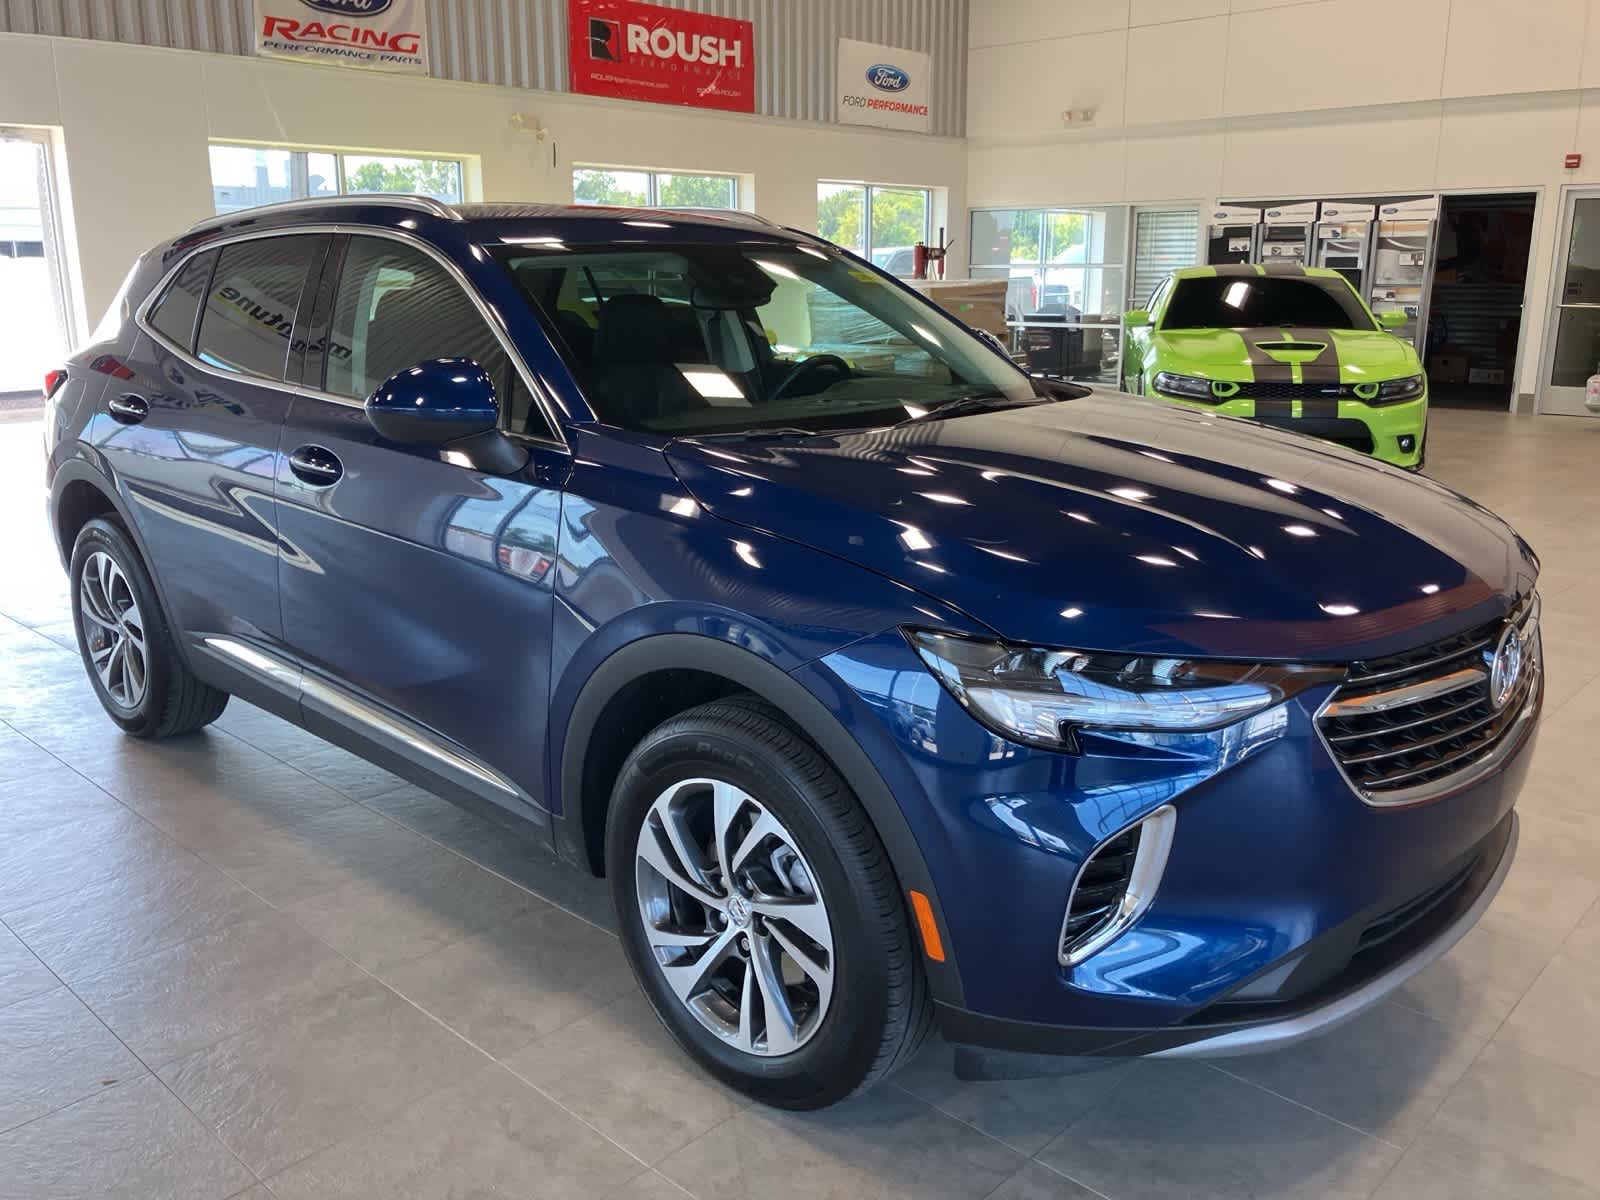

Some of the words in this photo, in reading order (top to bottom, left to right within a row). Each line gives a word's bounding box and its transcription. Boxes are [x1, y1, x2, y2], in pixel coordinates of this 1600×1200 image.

[263, 16, 421, 54] RACING
[627, 24, 742, 68] ROUSH
[264, 41, 376, 61] PERFORMANCE
[380, 55, 422, 65] PARTS
[874, 67, 903, 89] Ford
[842, 95, 866, 107] FORD
[867, 98, 929, 116] PERFORMANCE
